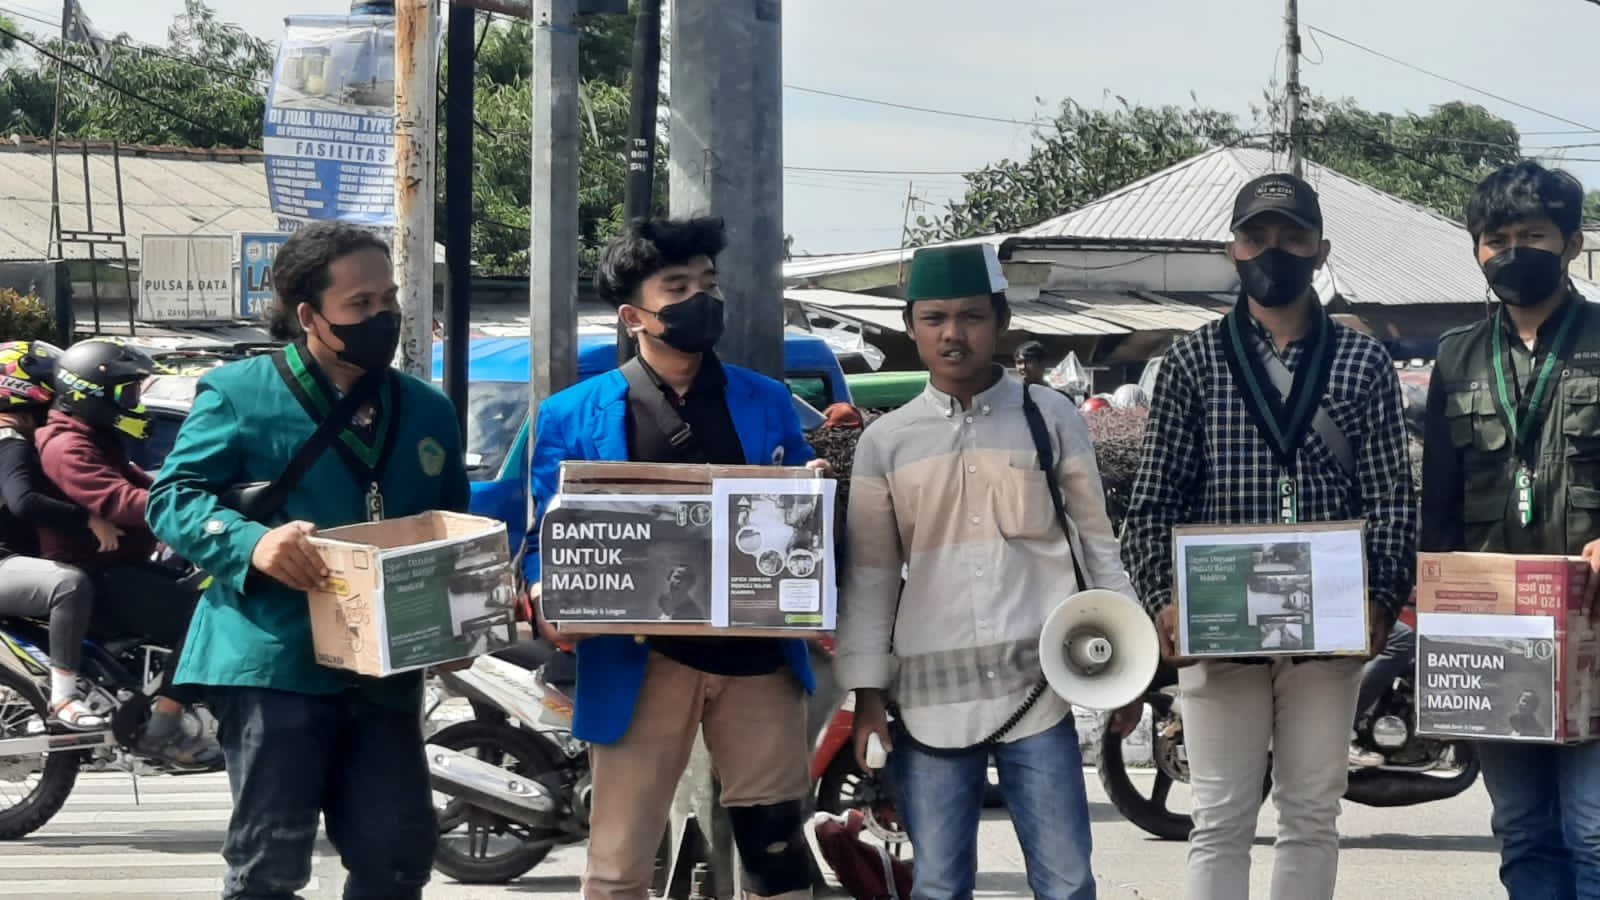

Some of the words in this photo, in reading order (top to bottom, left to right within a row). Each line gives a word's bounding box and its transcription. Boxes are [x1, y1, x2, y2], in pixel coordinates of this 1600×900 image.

[269, 109, 282, 124] DI
[283, 109, 312, 127] JUAL
[314, 111, 360, 131] RUMAH
[362, 117, 393, 134] TYPE
[296, 141, 387, 162] FASILITAS
[145, 280, 183, 291] PULSA
[198, 280, 228, 290] DATA
[551, 522, 651, 540] BANTUAN
[551, 548, 623, 565] UNTUK
[551, 573, 635, 591] MADINA
[1427, 653, 1505, 670] BANTUAN
[1427, 674, 1482, 690] UNTUK
[1427, 694, 1492, 711] MADINA
